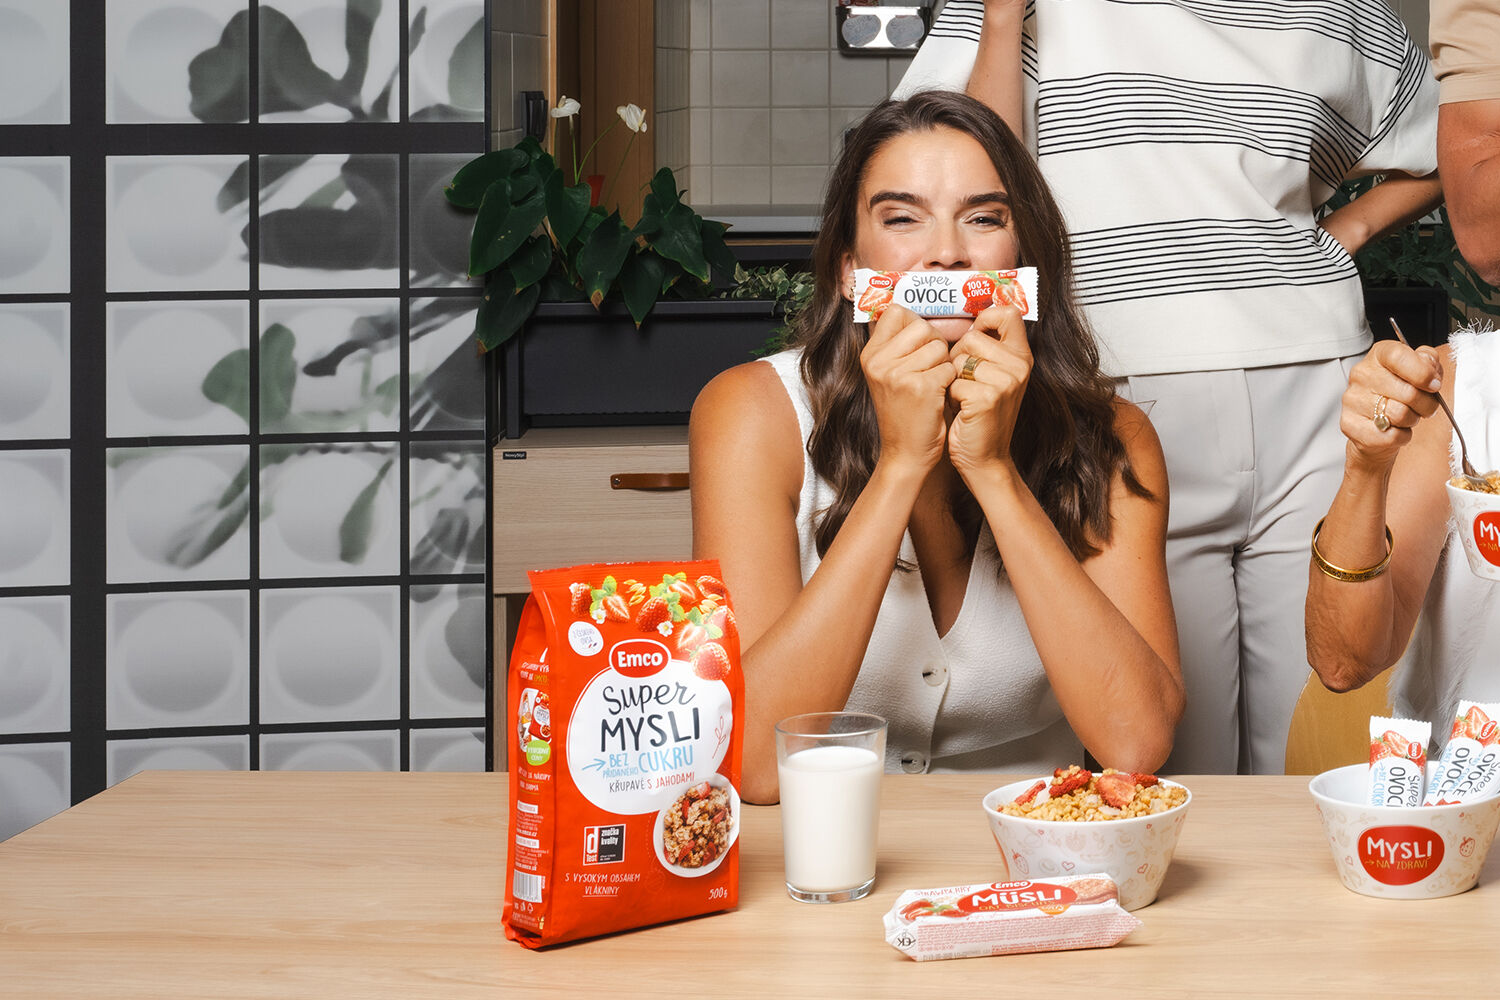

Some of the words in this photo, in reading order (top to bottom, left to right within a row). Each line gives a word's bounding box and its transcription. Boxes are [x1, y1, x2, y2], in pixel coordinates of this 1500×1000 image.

[871, 278, 890, 286] Emco
[911, 275, 952, 287] Super
[967, 281, 982, 290] 100
[904, 289, 957, 303] OVOCE
[971, 288, 991, 297] OVOCE
[924, 305, 955, 315] CUKRU
[1487, 544, 1499, 553] NA
[617, 651, 663, 668] Emco
[602, 682, 696, 715] Super
[601, 707, 700, 752] MYSLI
[609, 753, 629, 768] BEZ
[638, 744, 693, 773] CUKRU
[1437, 747, 1470, 797] OVOCE
[1452, 753, 1496, 797] OVOCE
[609, 779, 645, 793] KŘUPAVÉ
[647, 779, 652, 790] S
[655, 771, 695, 789] JAHODAMI
[1386, 767, 1405, 807] OVOC
[1406, 775, 1420, 807] Super
[587, 825, 598, 854] d
[601, 828, 619, 837] značka
[601, 837, 619, 846] kvality
[1367, 836, 1432, 864] MYSLI
[1376, 859, 1390, 869] NA
[565, 872, 570, 882] S
[573, 872, 608, 883] VYSOKÝM
[610, 872, 641, 883] OBSAHEM
[995, 880, 1028, 889] Emco
[584, 885, 620, 895] VLÁKNINY
[972, 889, 1062, 907] MÜSLI
